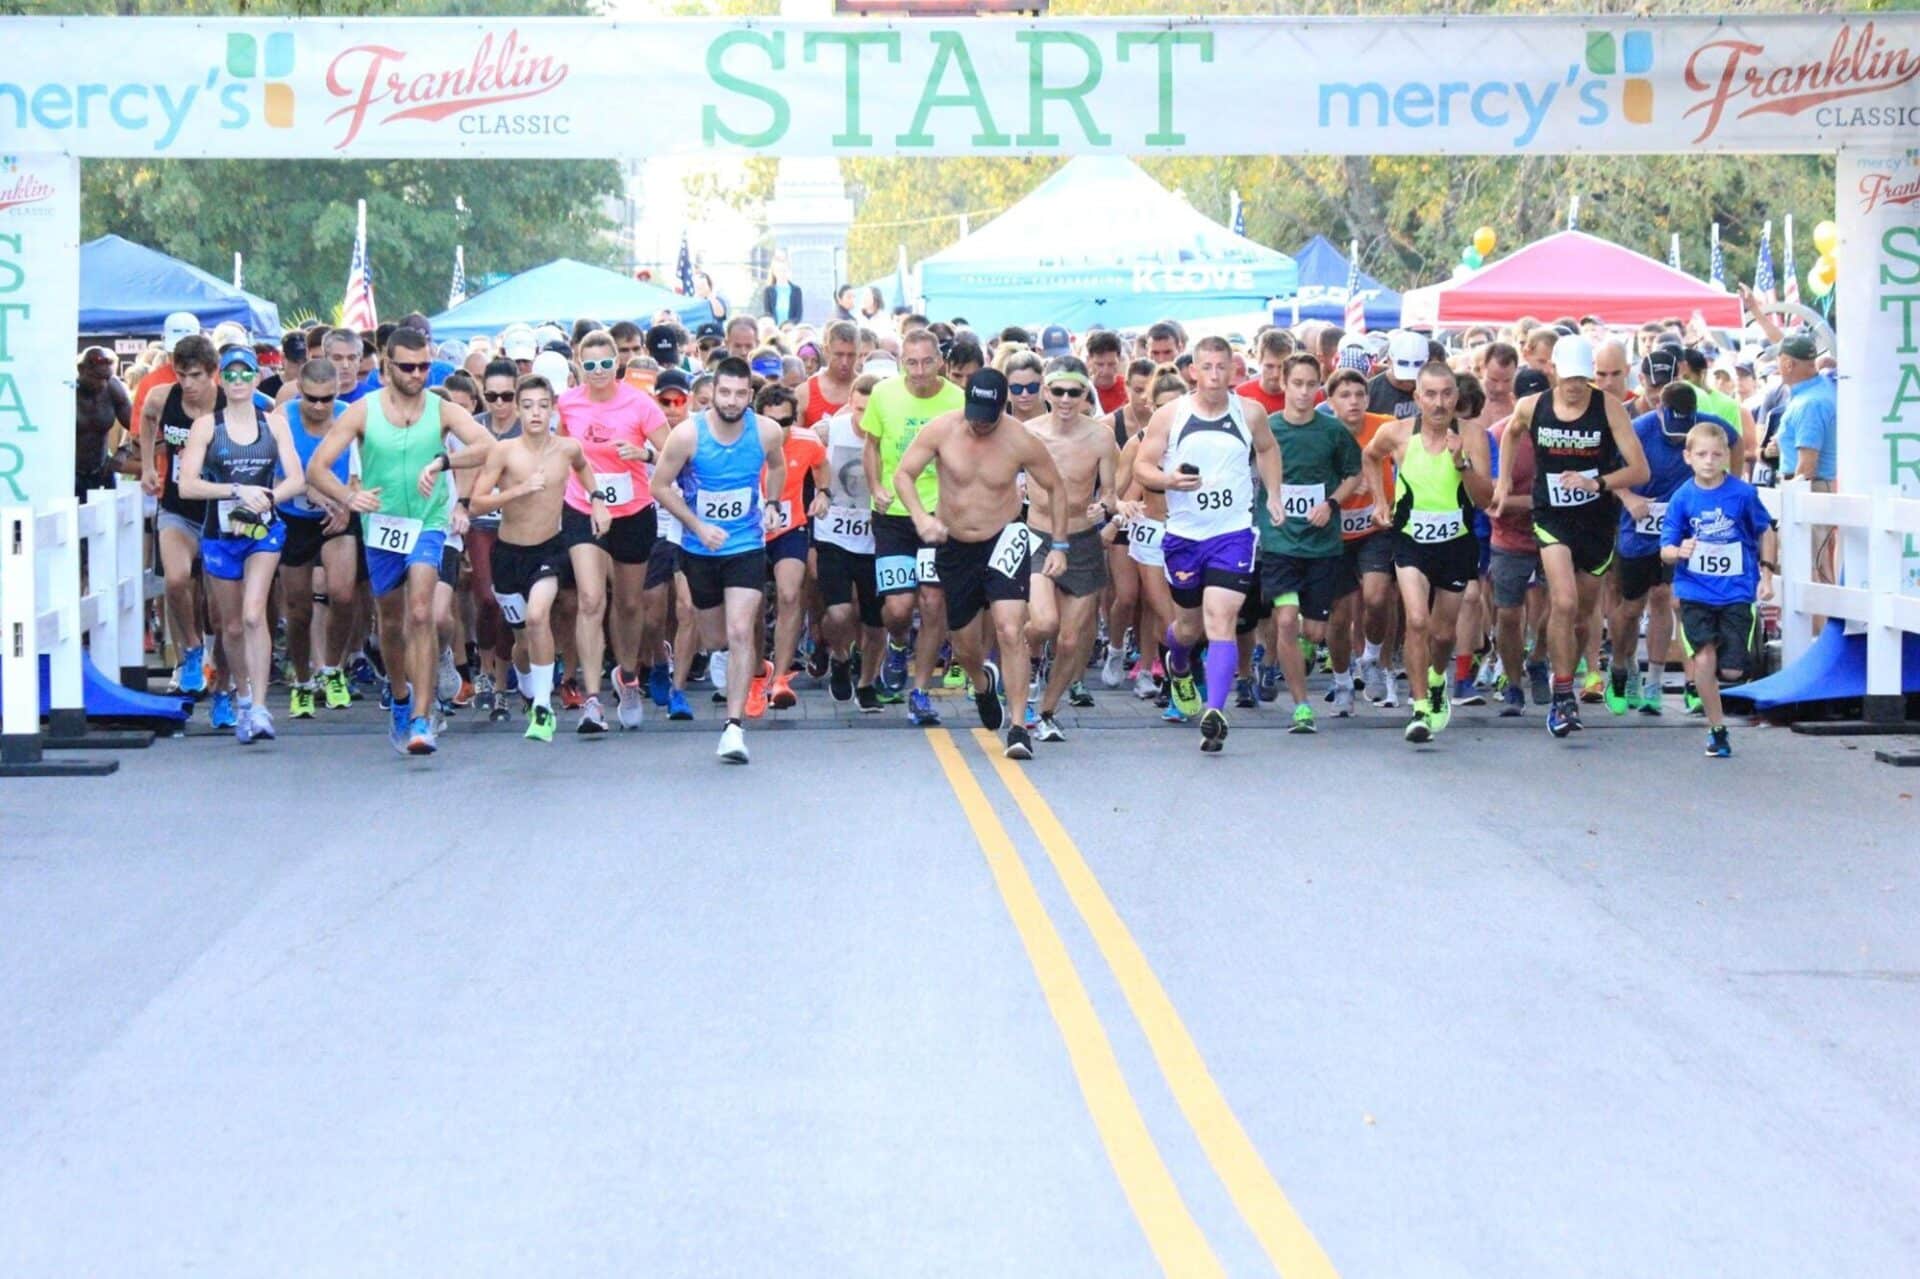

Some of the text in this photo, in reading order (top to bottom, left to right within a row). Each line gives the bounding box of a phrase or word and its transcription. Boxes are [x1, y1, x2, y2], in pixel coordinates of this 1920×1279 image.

[324, 28, 569, 150] Franklin
[701, 30, 1214, 147] START
[1682, 20, 1920, 144] Franklin
[1318, 63, 1609, 147] mercy's
[459, 115, 571, 134] CLASSIC
[1816, 107, 1920, 128] CLASSIC
[705, 501, 742, 519] 268
[1197, 488, 1233, 511] 938
[833, 518, 869, 536] 2161
[1413, 521, 1460, 540] 2243
[379, 526, 409, 551] 781
[1699, 555, 1731, 573] 159
[879, 567, 917, 588] 1304
